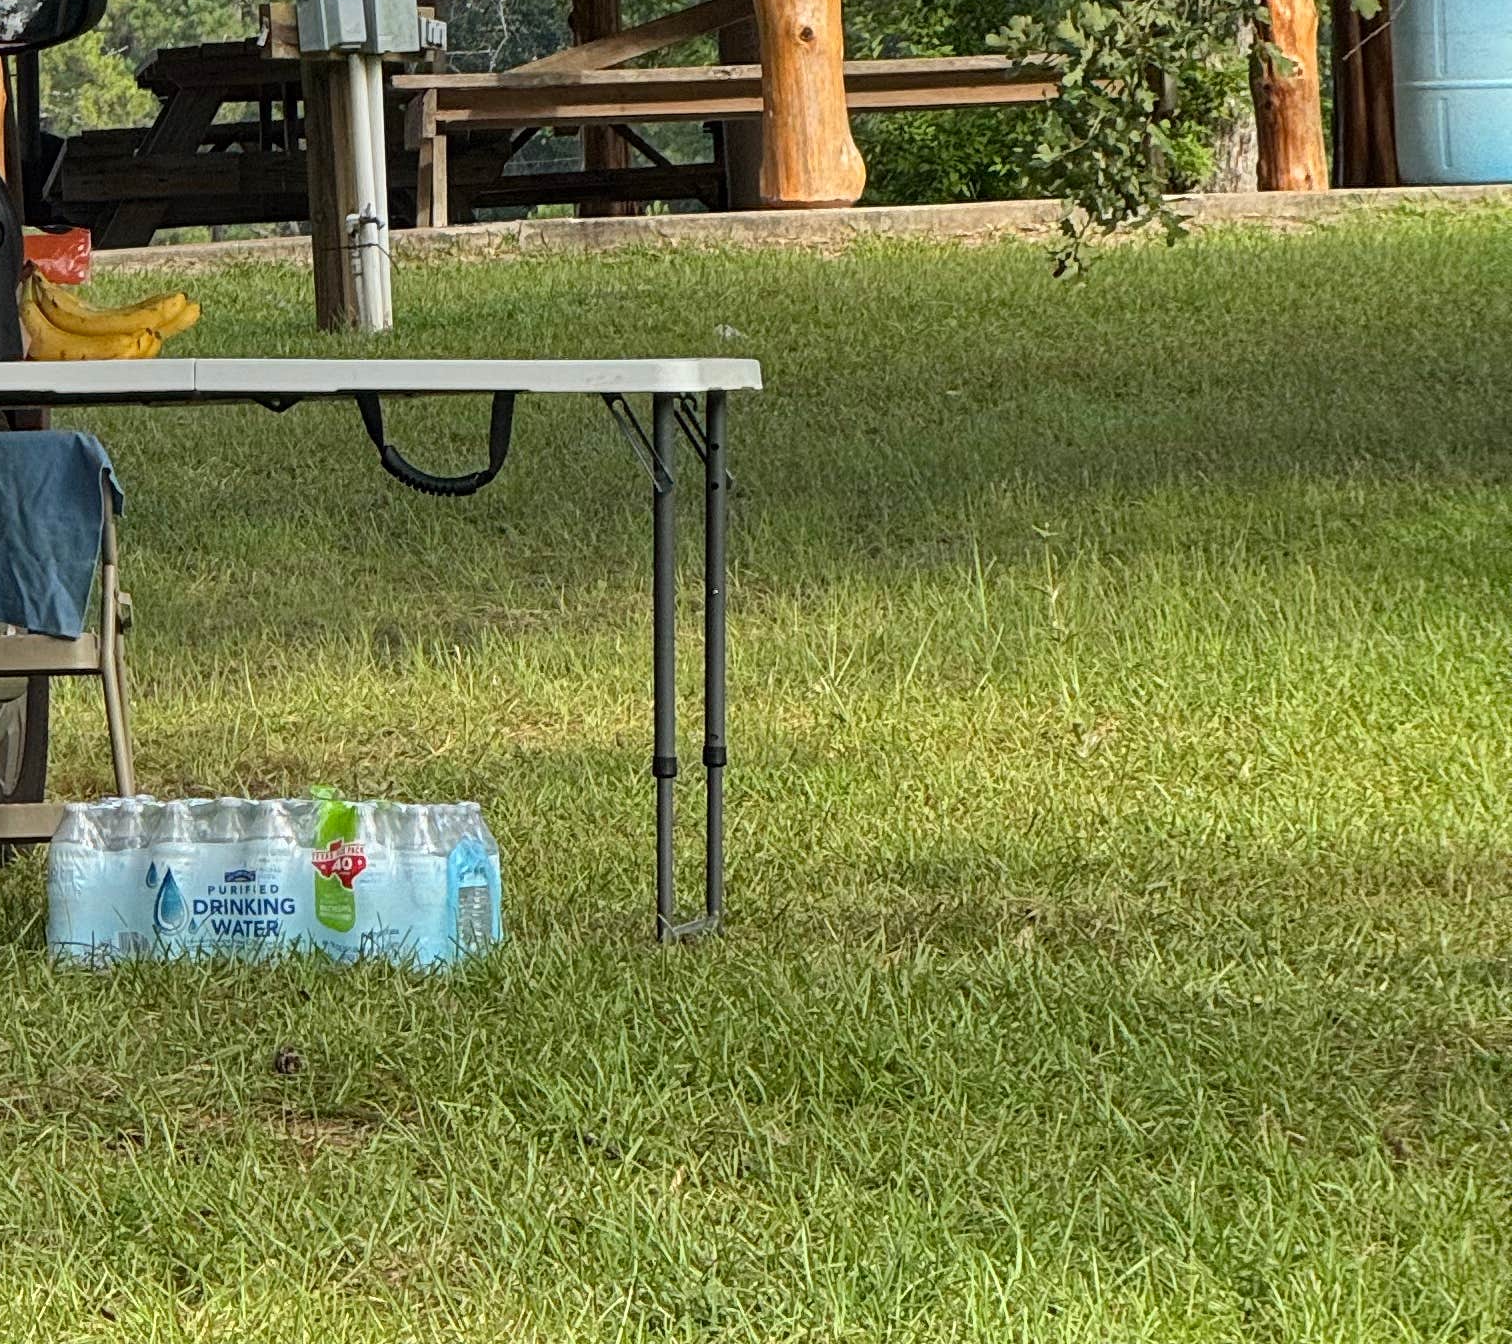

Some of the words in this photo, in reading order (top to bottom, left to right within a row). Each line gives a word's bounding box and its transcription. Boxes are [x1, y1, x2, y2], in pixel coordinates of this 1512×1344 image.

[331, 856, 353, 872] 40
[208, 884, 279, 895] PURIFIED
[192, 898, 296, 915] DRINKING
[211, 918, 280, 938] WATER
